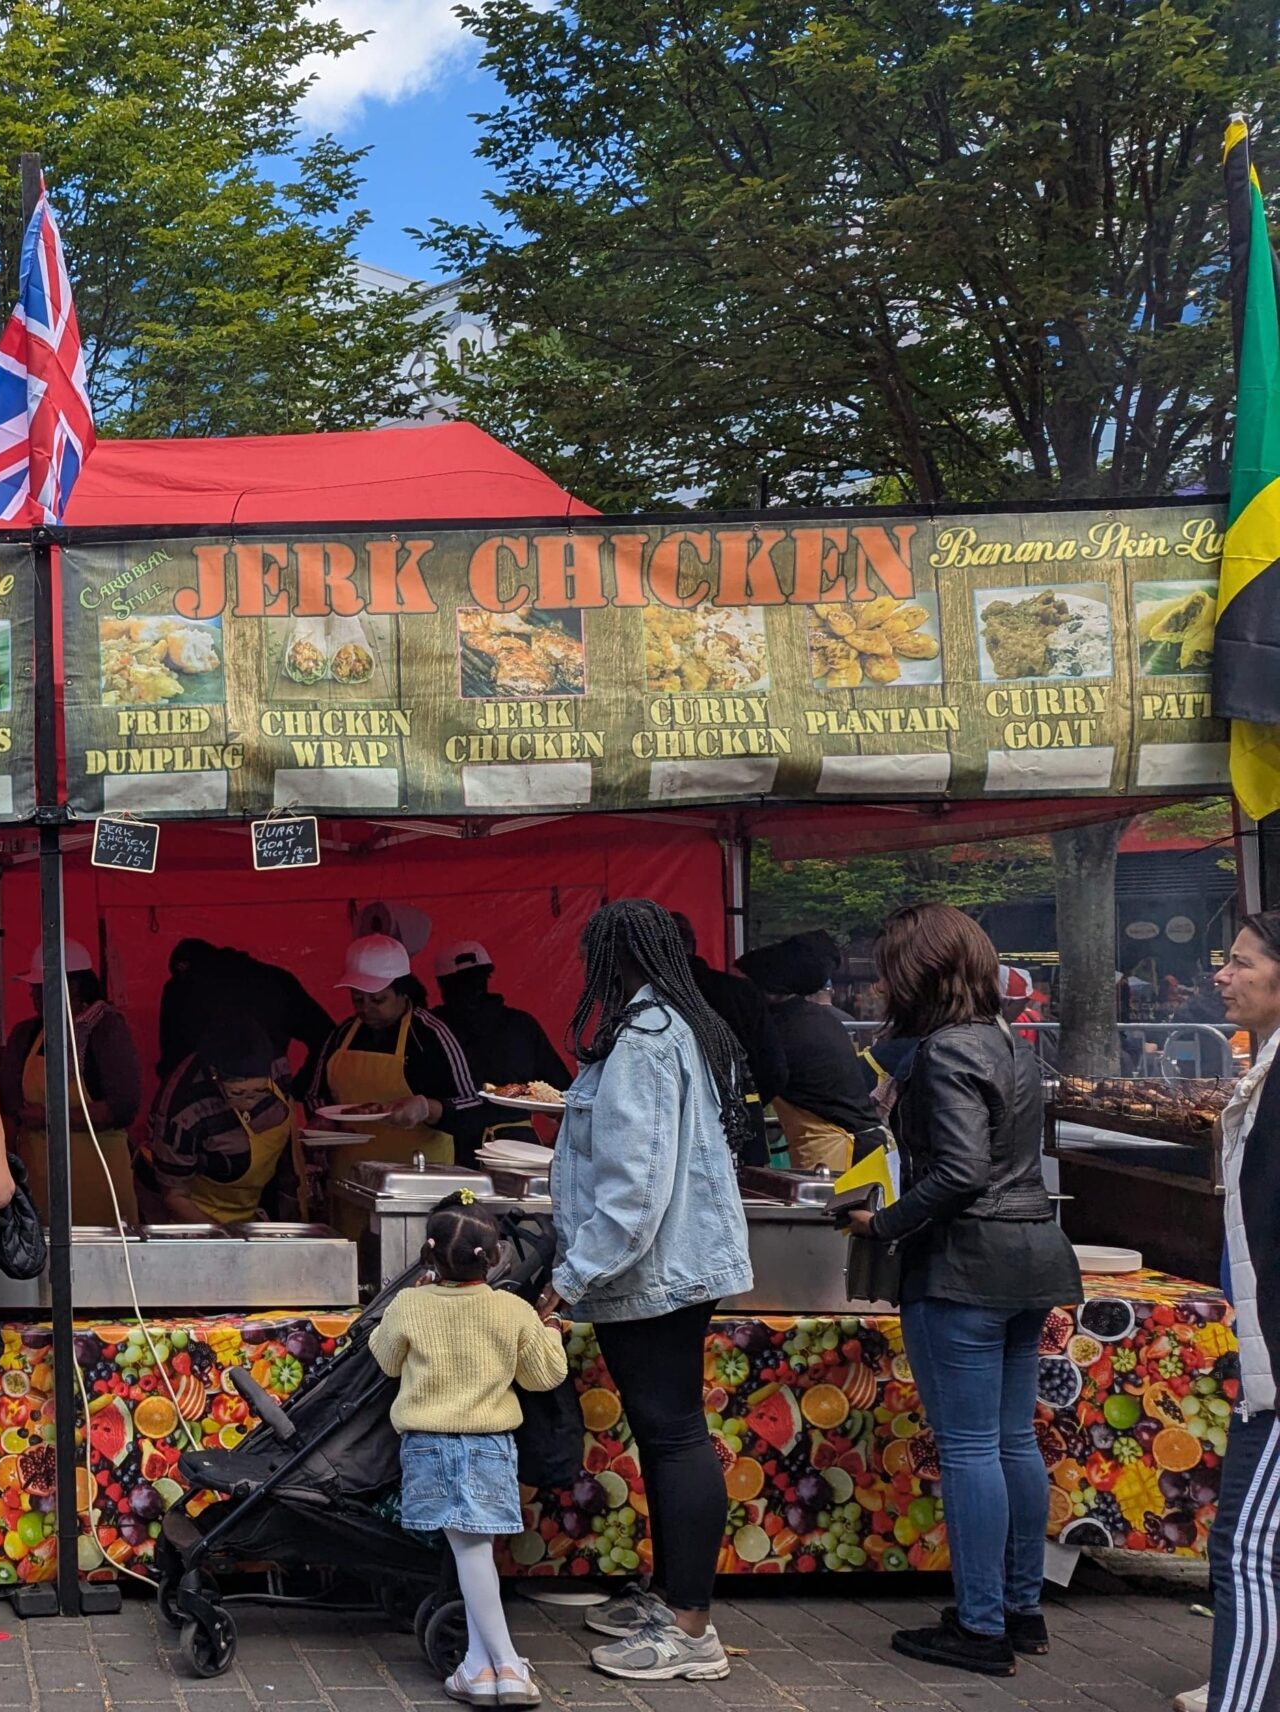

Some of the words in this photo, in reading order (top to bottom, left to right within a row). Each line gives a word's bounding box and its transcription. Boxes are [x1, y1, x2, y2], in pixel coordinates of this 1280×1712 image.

[928, 524, 1078, 569] Banana
[1079, 521, 1172, 561] Skin
[1175, 518, 1225, 563] Lu
[79, 547, 174, 609] CARIBBEAN
[173, 538, 438, 620] JERK
[467, 525, 918, 612] CHICKEN
[111, 582, 169, 619] STYLE
[476, 700, 574, 731] JERK
[649, 697, 770, 727] CURRY
[985, 685, 1110, 719] CURRY
[1141, 691, 1212, 720] PATT
[117, 708, 211, 737] FRIED
[260, 708, 413, 738] CHICKEN
[804, 706, 962, 736] PLANTAIN
[1003, 719, 1097, 751] GOAT
[290, 740, 389, 768] WRAP
[444, 731, 607, 763] CHICKEN
[631, 727, 792, 760] CHICKEN
[85, 743, 245, 775] DUMPLING
[98, 833, 150, 847] CHICKEN
[99, 823, 134, 837] JERK
[255, 825, 304, 838] CURRY
[257, 838, 296, 851] GOAT
[111, 852, 144, 867] £15
[276, 854, 305, 866] £15
